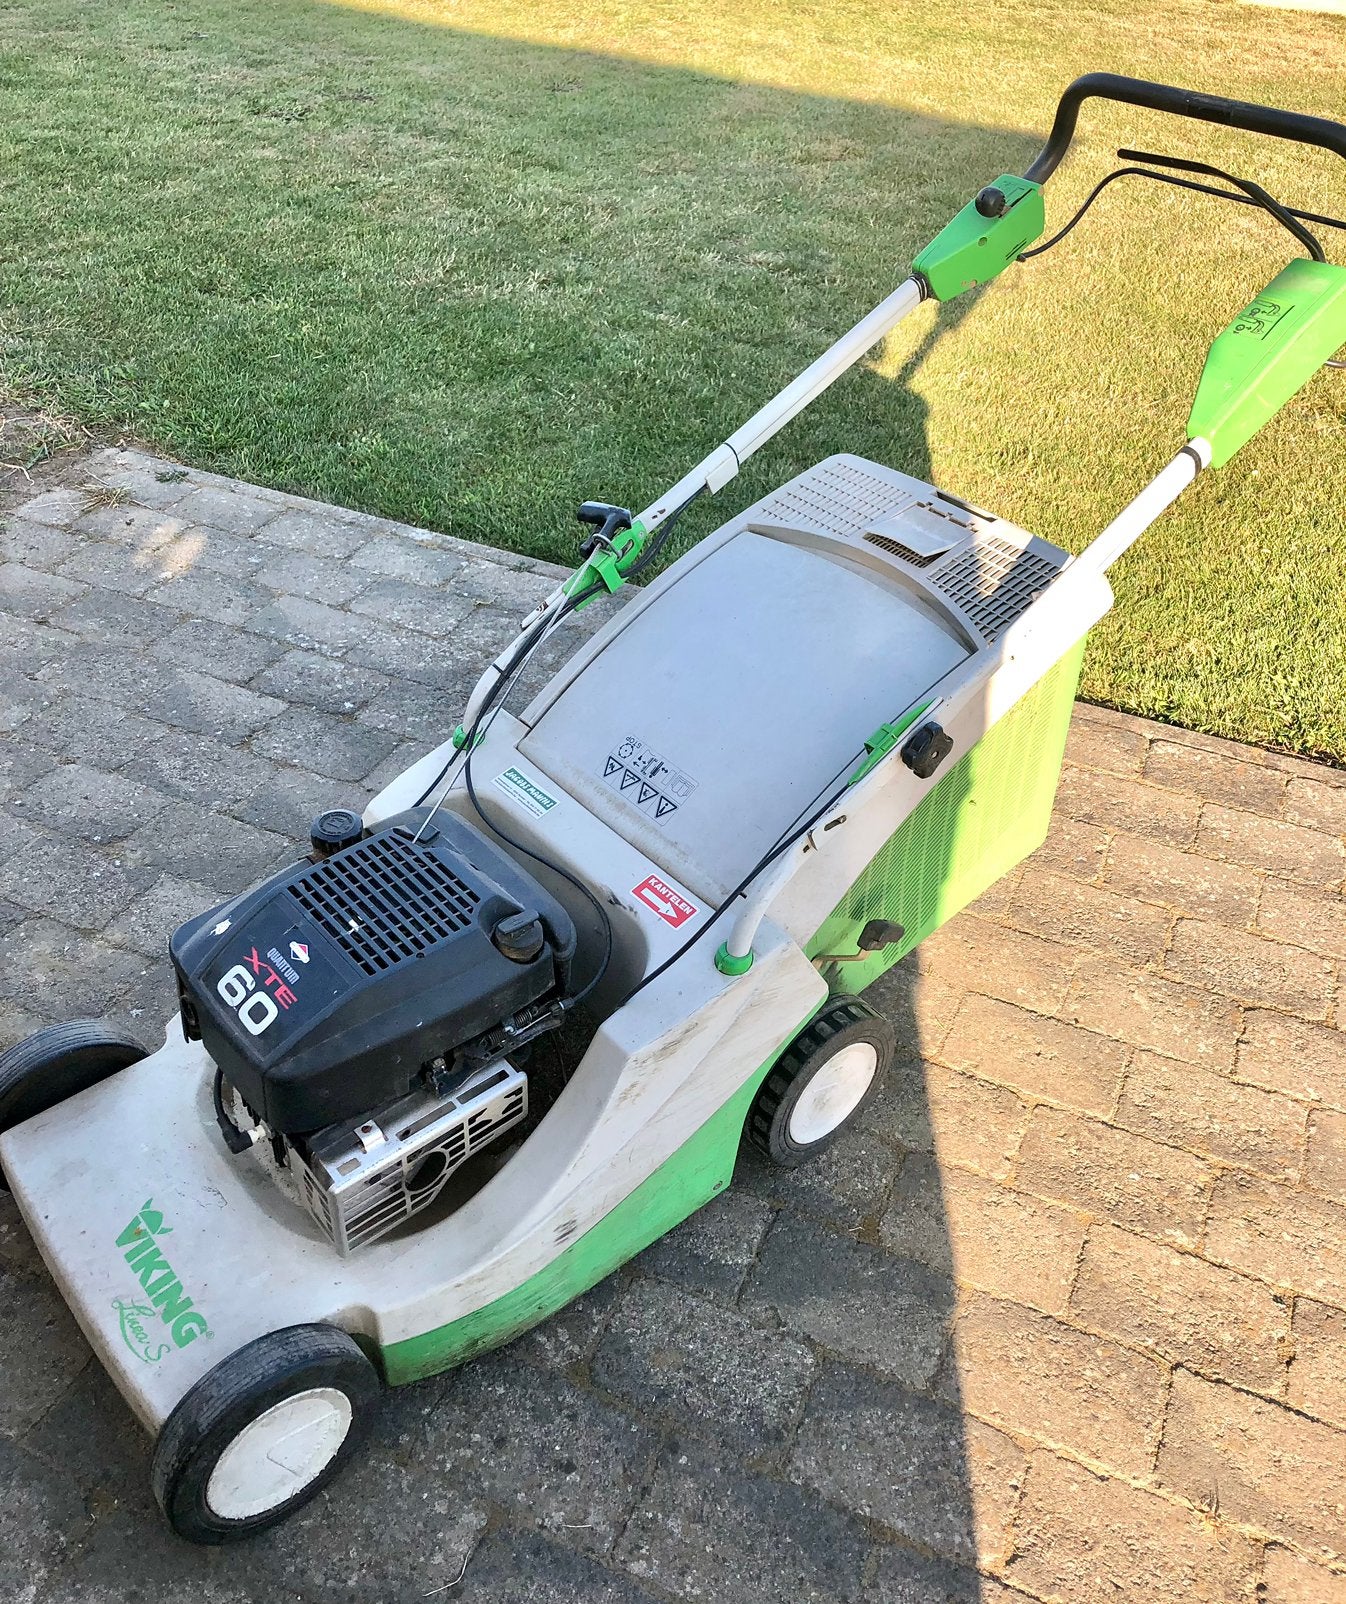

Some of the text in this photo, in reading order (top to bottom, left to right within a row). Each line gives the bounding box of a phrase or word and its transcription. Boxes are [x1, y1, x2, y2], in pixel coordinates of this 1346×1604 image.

[625, 736, 642, 749] STOP
[648, 877, 693, 915] KANTELEN
[242, 946, 298, 1010] XTE
[266, 947, 300, 985] QUANTUM
[216, 964, 279, 1036] 60
[114, 1214, 208, 1349] VIKING
[111, 1297, 171, 1363] Linea S
